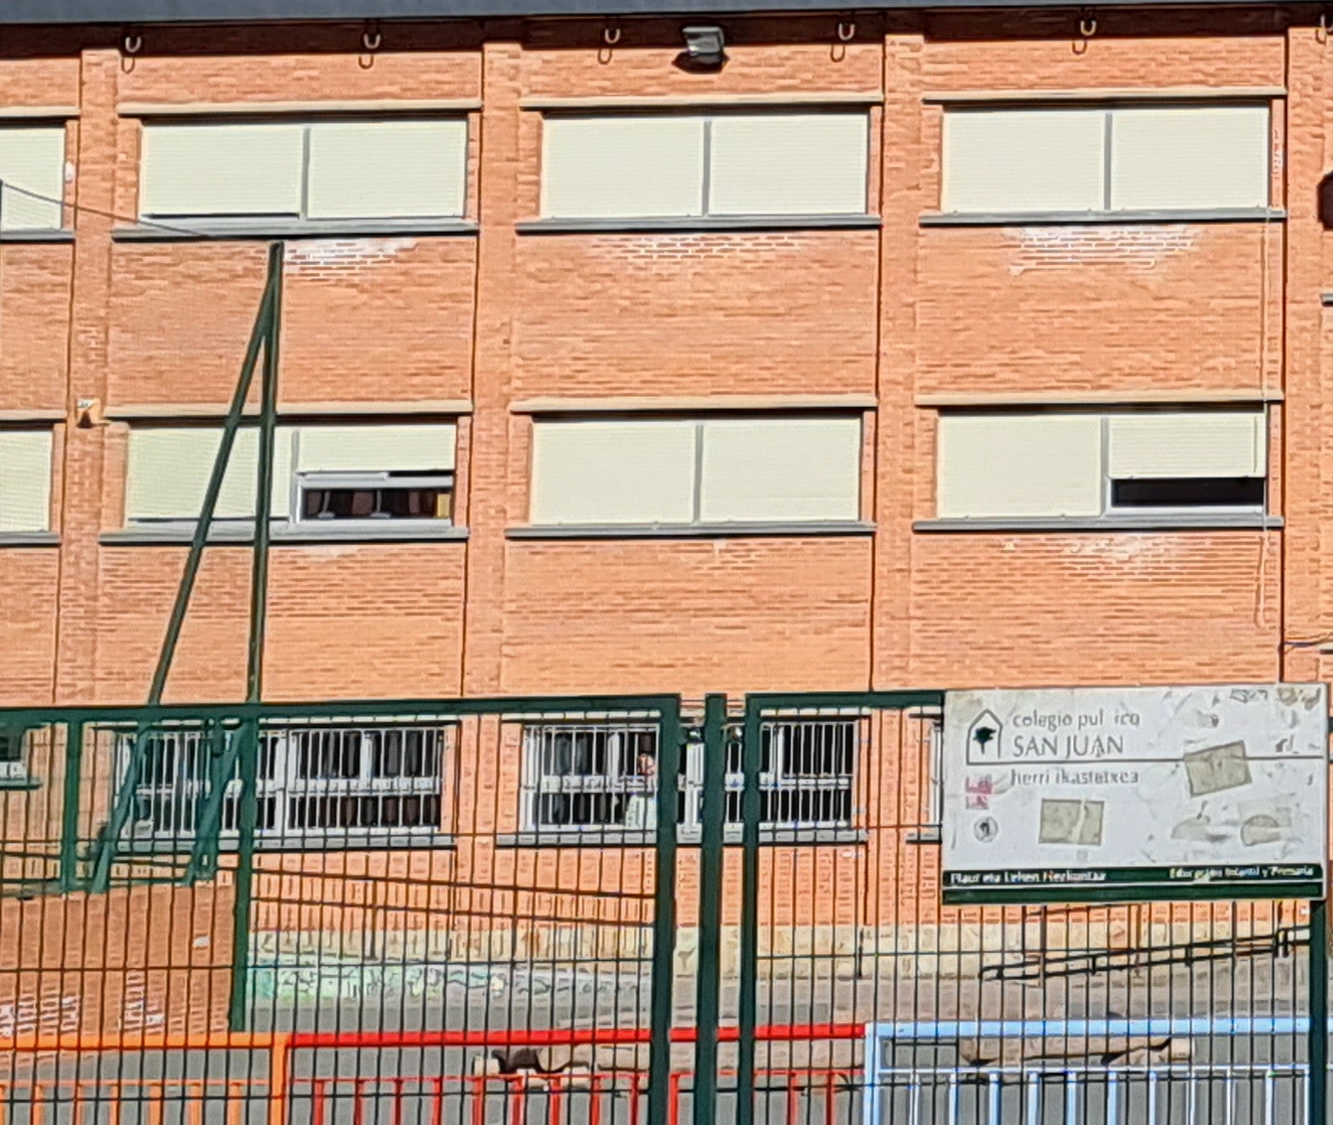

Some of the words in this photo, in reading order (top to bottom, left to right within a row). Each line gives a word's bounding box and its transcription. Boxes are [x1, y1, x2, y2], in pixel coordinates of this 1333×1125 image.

[1012, 709, 1073, 732] colegio
[1012, 735, 1059, 758] SAN
[1065, 734, 1124, 759] JUAN
[1010, 769, 1050, 786] herri
